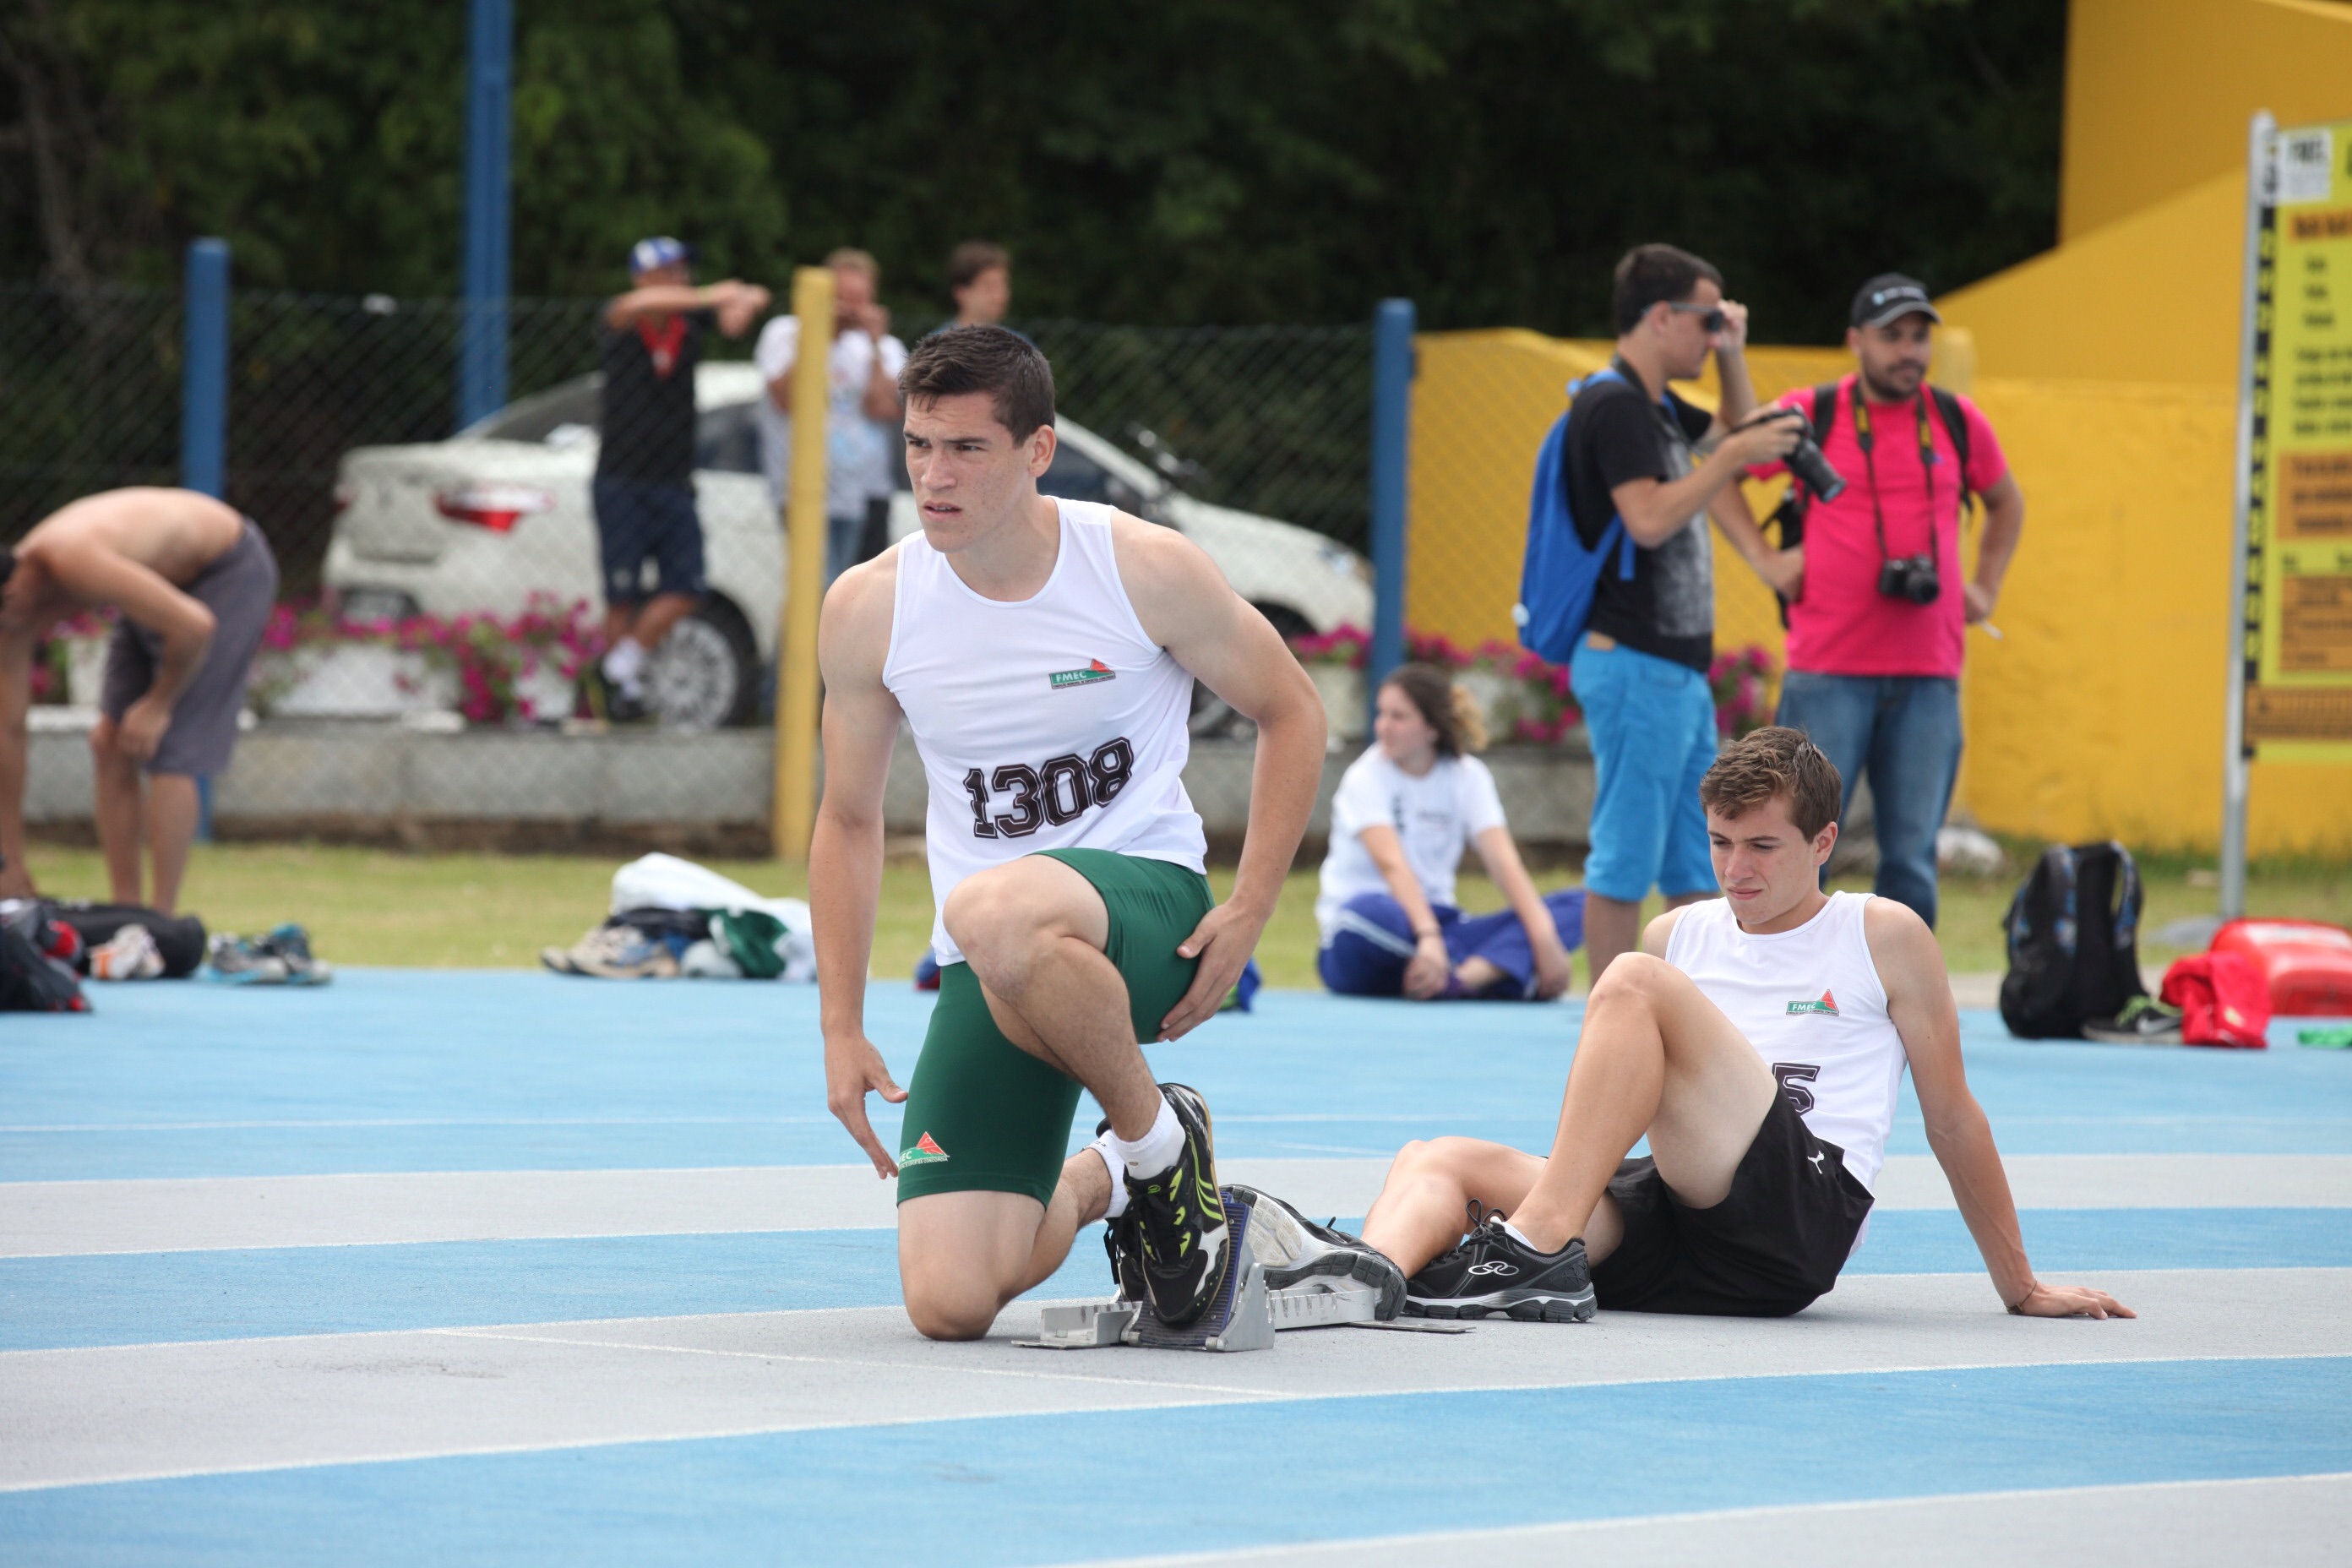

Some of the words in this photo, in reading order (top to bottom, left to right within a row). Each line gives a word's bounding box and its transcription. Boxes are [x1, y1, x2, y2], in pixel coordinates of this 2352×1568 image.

[1055, 671, 1087, 683] FMEC
[962, 736, 1135, 840] 1308
[1792, 1003, 1816, 1011] FMEC
[1772, 1062, 1821, 1116] 5
[900, 1151, 912, 1162] EC
